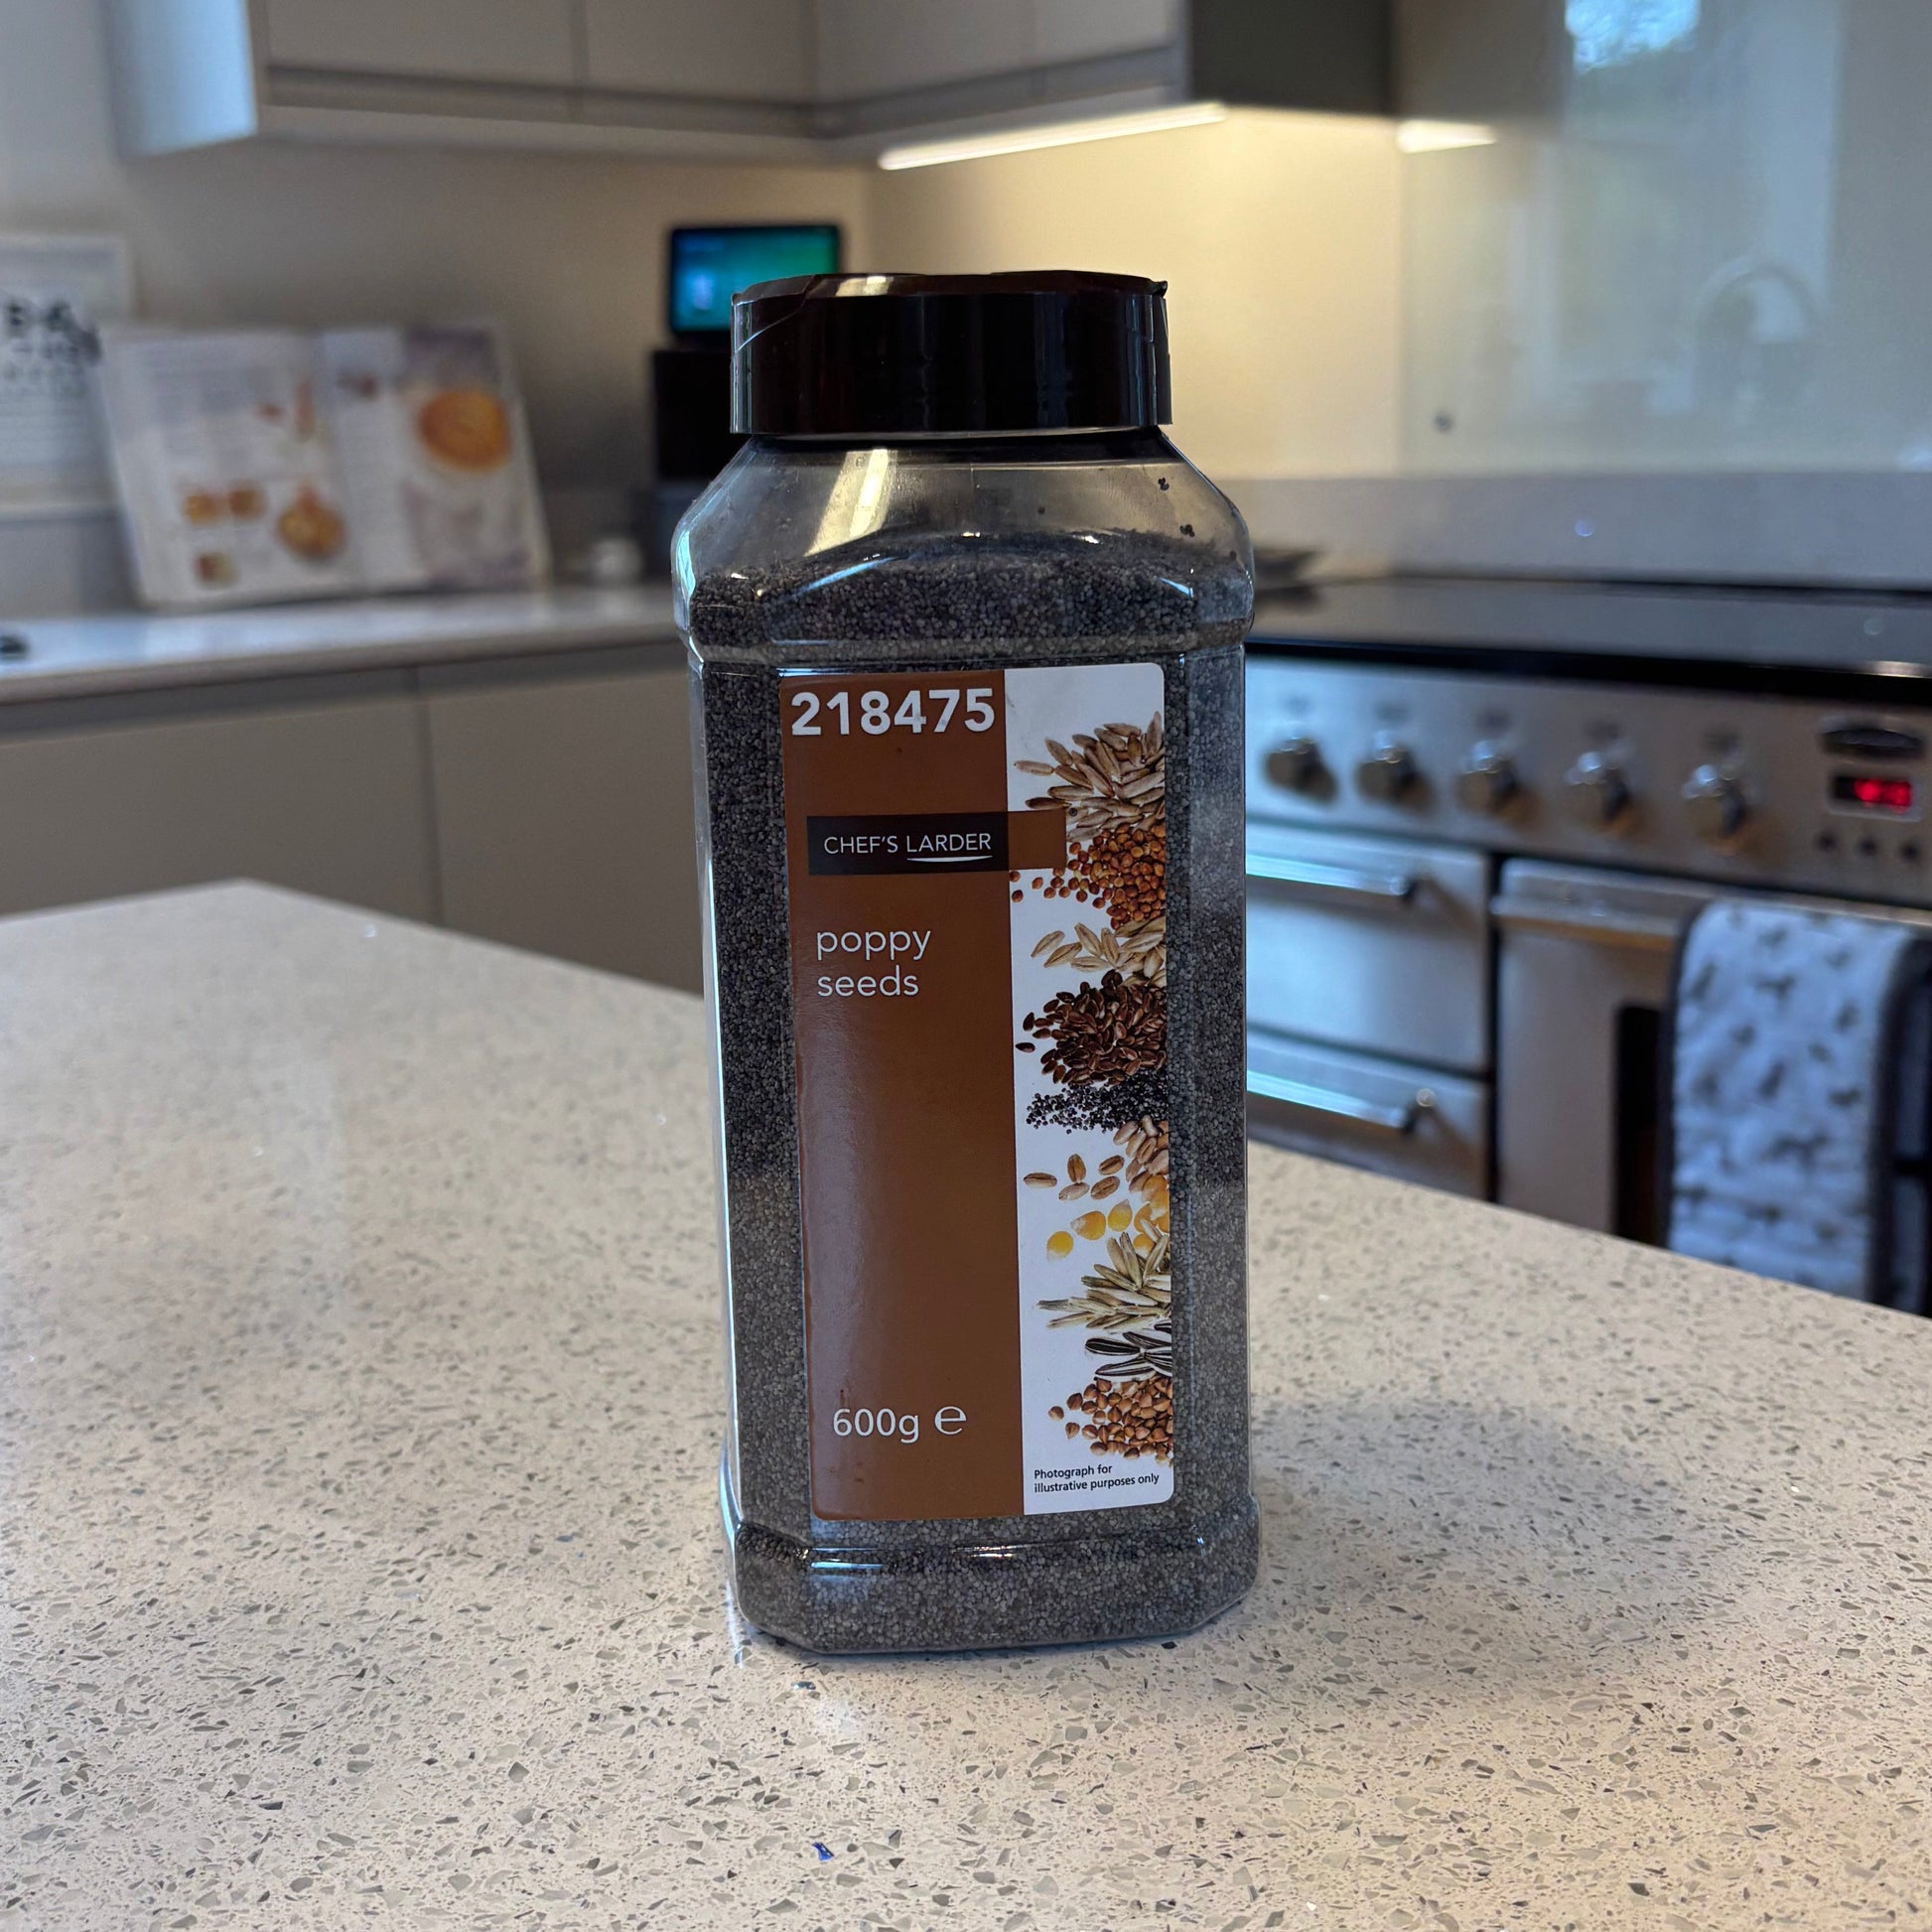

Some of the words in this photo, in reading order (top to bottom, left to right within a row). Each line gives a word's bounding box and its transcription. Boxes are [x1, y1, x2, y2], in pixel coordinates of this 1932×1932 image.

[790, 687, 995, 736] 218475
[823, 834, 898, 855] CHEF'S
[905, 832, 992, 854] LARDER
[816, 929, 931, 960] poppy
[817, 964, 919, 998] seeds
[832, 1407, 919, 1445] 600g
[1034, 1465, 1094, 1479] Photograph
[1096, 1463, 1113, 1475] for
[1034, 1479, 1088, 1493] illustrative
[1090, 1477, 1136, 1491] purposes
[1137, 1472, 1160, 1486] only
